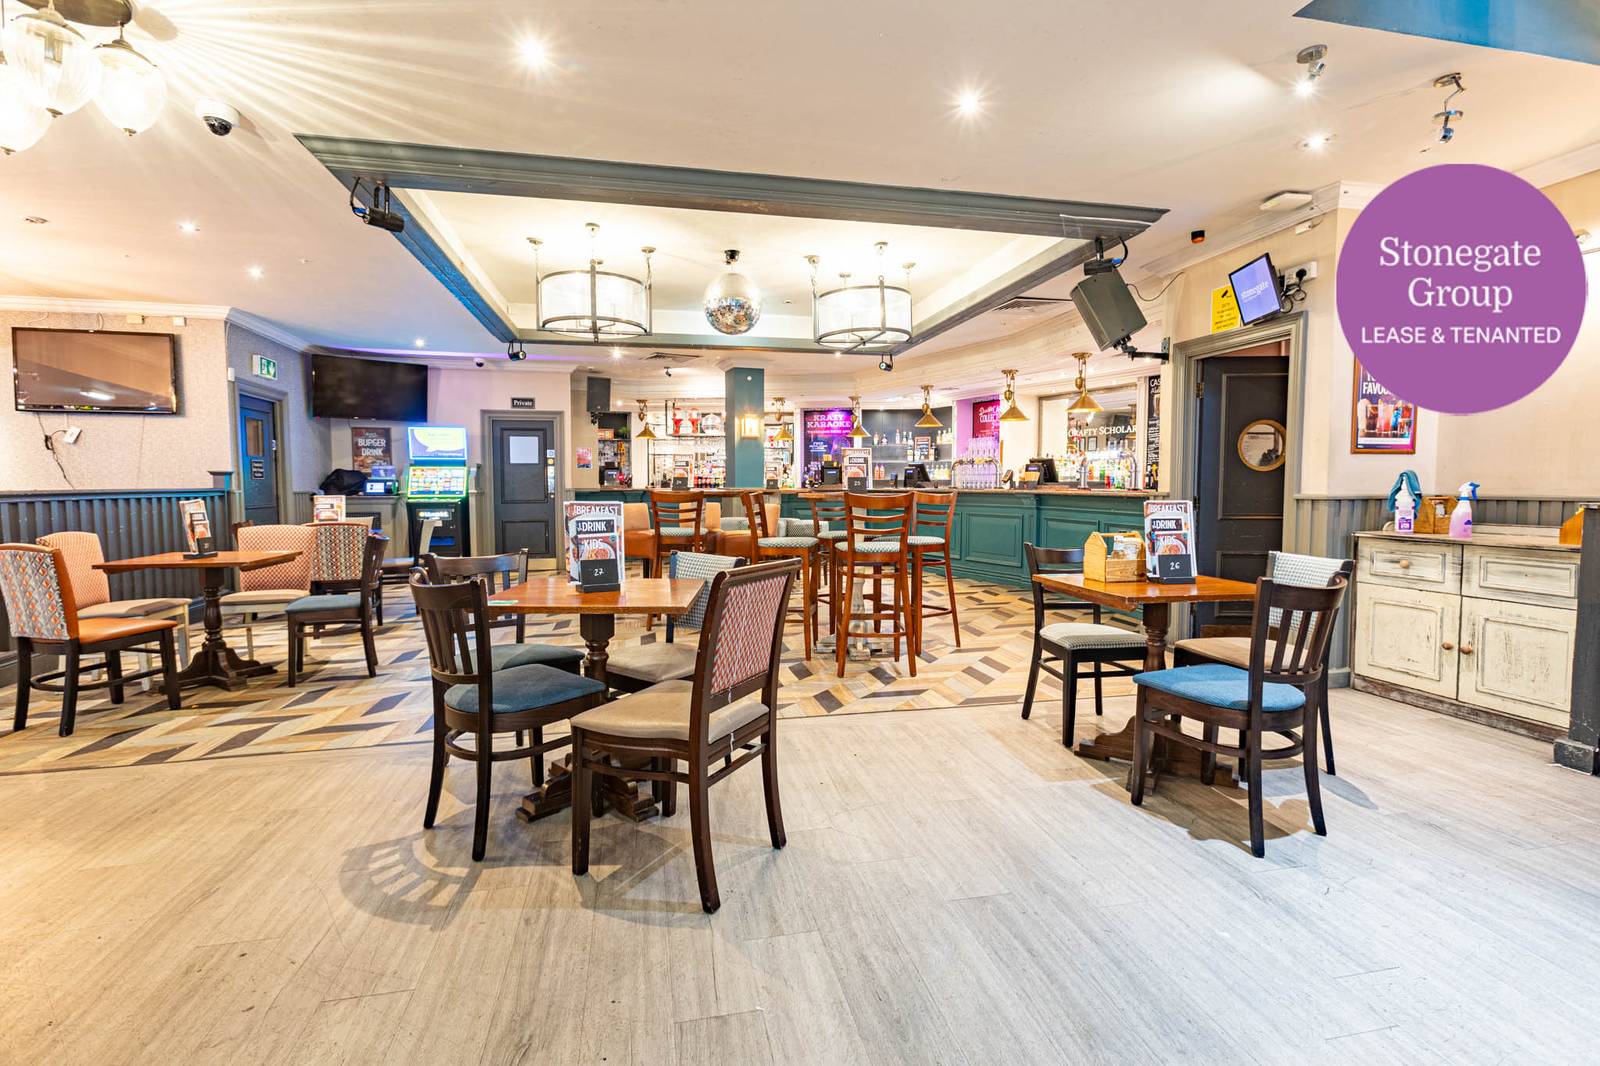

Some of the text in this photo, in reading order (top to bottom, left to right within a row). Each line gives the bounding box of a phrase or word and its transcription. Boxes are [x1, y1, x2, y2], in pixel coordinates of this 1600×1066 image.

[1363, 381, 1391, 395] FAVOU
[1098, 425, 1137, 435] SCHOLAR
[358, 438, 386, 448] BURGER
[362, 447, 383, 456] DRINK
[576, 505, 618, 515] BREAKFAST
[1150, 504, 1185, 513] BREAKFAST
[582, 521, 607, 532] DRINK
[1157, 519, 1177, 530] DRINK
[584, 538, 604, 549] KIDS
[593, 568, 605, 577] 27
